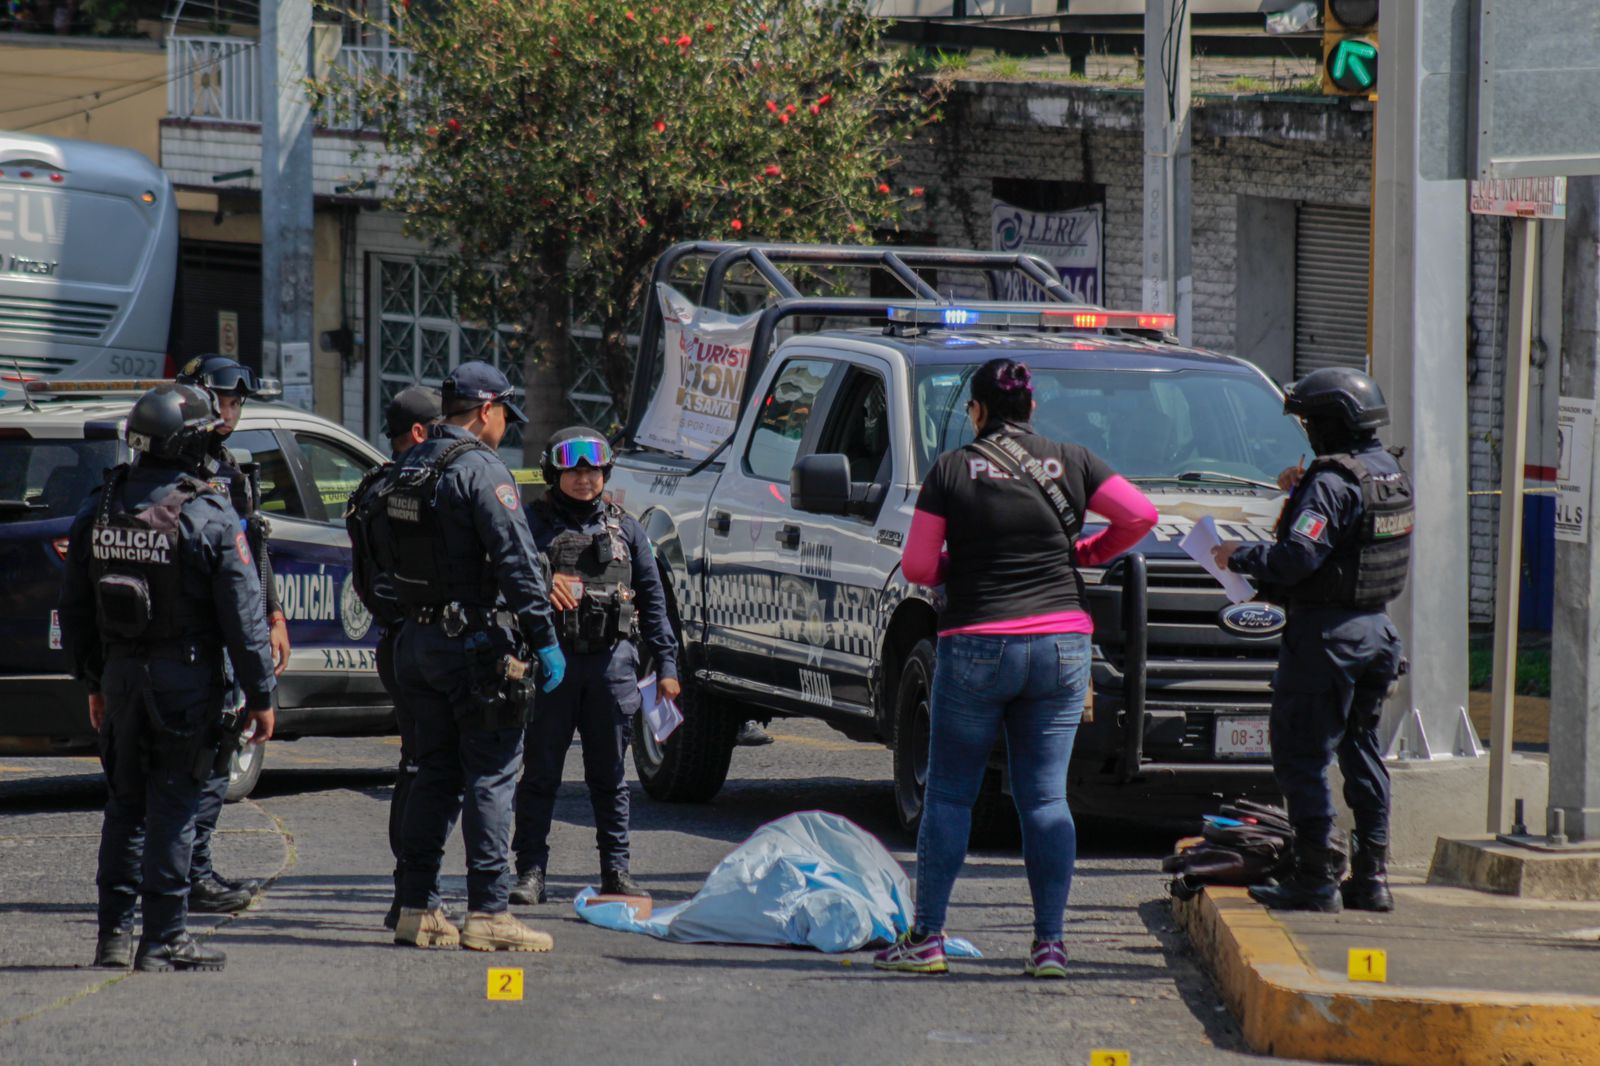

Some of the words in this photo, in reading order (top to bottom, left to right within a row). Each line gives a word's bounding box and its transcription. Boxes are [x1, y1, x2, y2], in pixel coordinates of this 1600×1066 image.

[109, 354, 157, 378] 5022
[693, 396, 732, 418] SANTA
[1000, 437, 1028, 461] PINK
[1025, 458, 1053, 487] PINK
[1047, 484, 1071, 513] PINK
[92, 527, 170, 550] POLICÍA
[92, 544, 170, 564] MUNICIPAL
[274, 563, 335, 620] POLICÍA
[1239, 610, 1273, 627] Ford
[321, 648, 377, 670] XALAP
[1363, 954, 1372, 975] 1
[500, 973, 512, 993] 2
